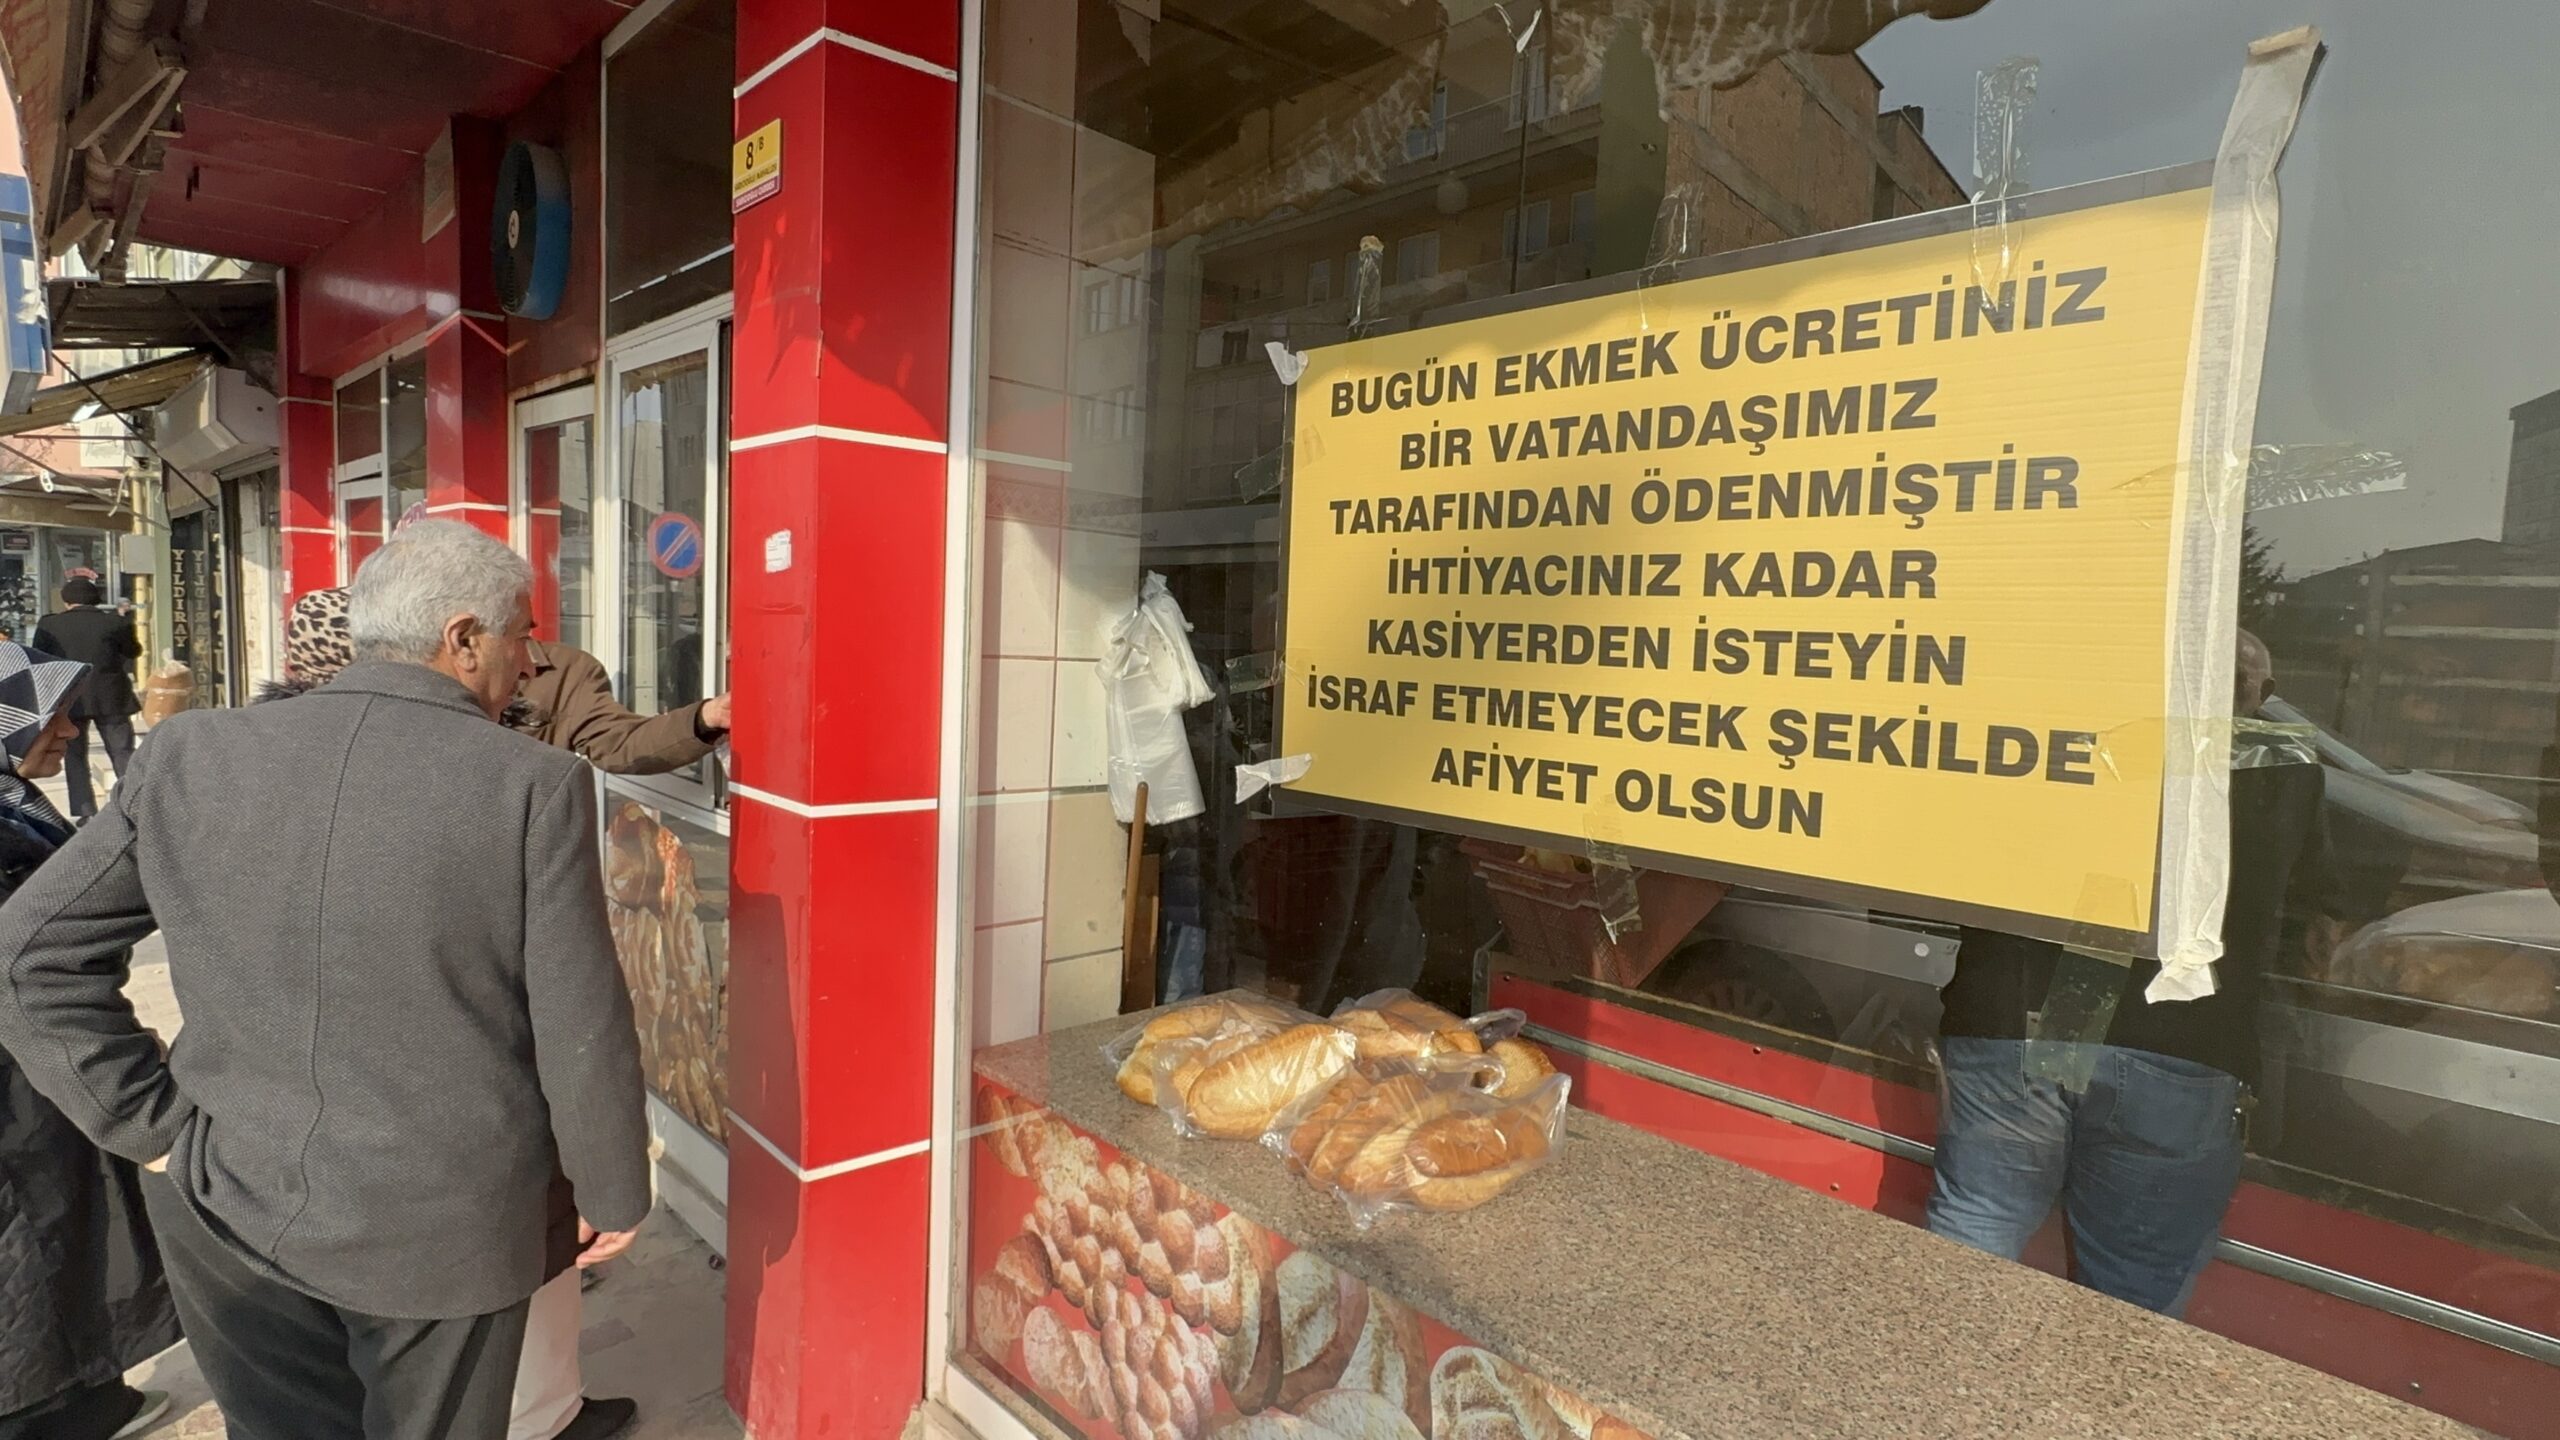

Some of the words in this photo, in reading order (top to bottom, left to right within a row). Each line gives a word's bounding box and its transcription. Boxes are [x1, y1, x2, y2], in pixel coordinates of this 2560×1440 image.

[1331, 357, 1478, 418] BUGÜN
[1495, 331, 1678, 396] EKMEK
[1700, 260, 2107, 370] ÜCRETİNİZ
[1401, 420, 1471, 470] BİR
[1489, 378, 1938, 463] VATANDAŞIMIZ
[1330, 484, 1610, 534] TARAFINDAN
[1631, 443, 2079, 530] ÖDENMİŞTİR
[172, 549, 188, 648] YILDIRAY
[1388, 546, 1681, 596] İHTİYACINIZ
[1704, 550, 1936, 598] KADAR
[1368, 610, 1670, 669] KASİYERDEN
[1693, 615, 1966, 686] İSTEYİN
[1308, 665, 1418, 717] İSRAF
[1432, 684, 1747, 751] ETMEYECEK
[1768, 705, 2097, 786] ŞEKİLDE
[1431, 742, 1598, 804] AFİYET
[1615, 770, 1822, 837] OLSUN
